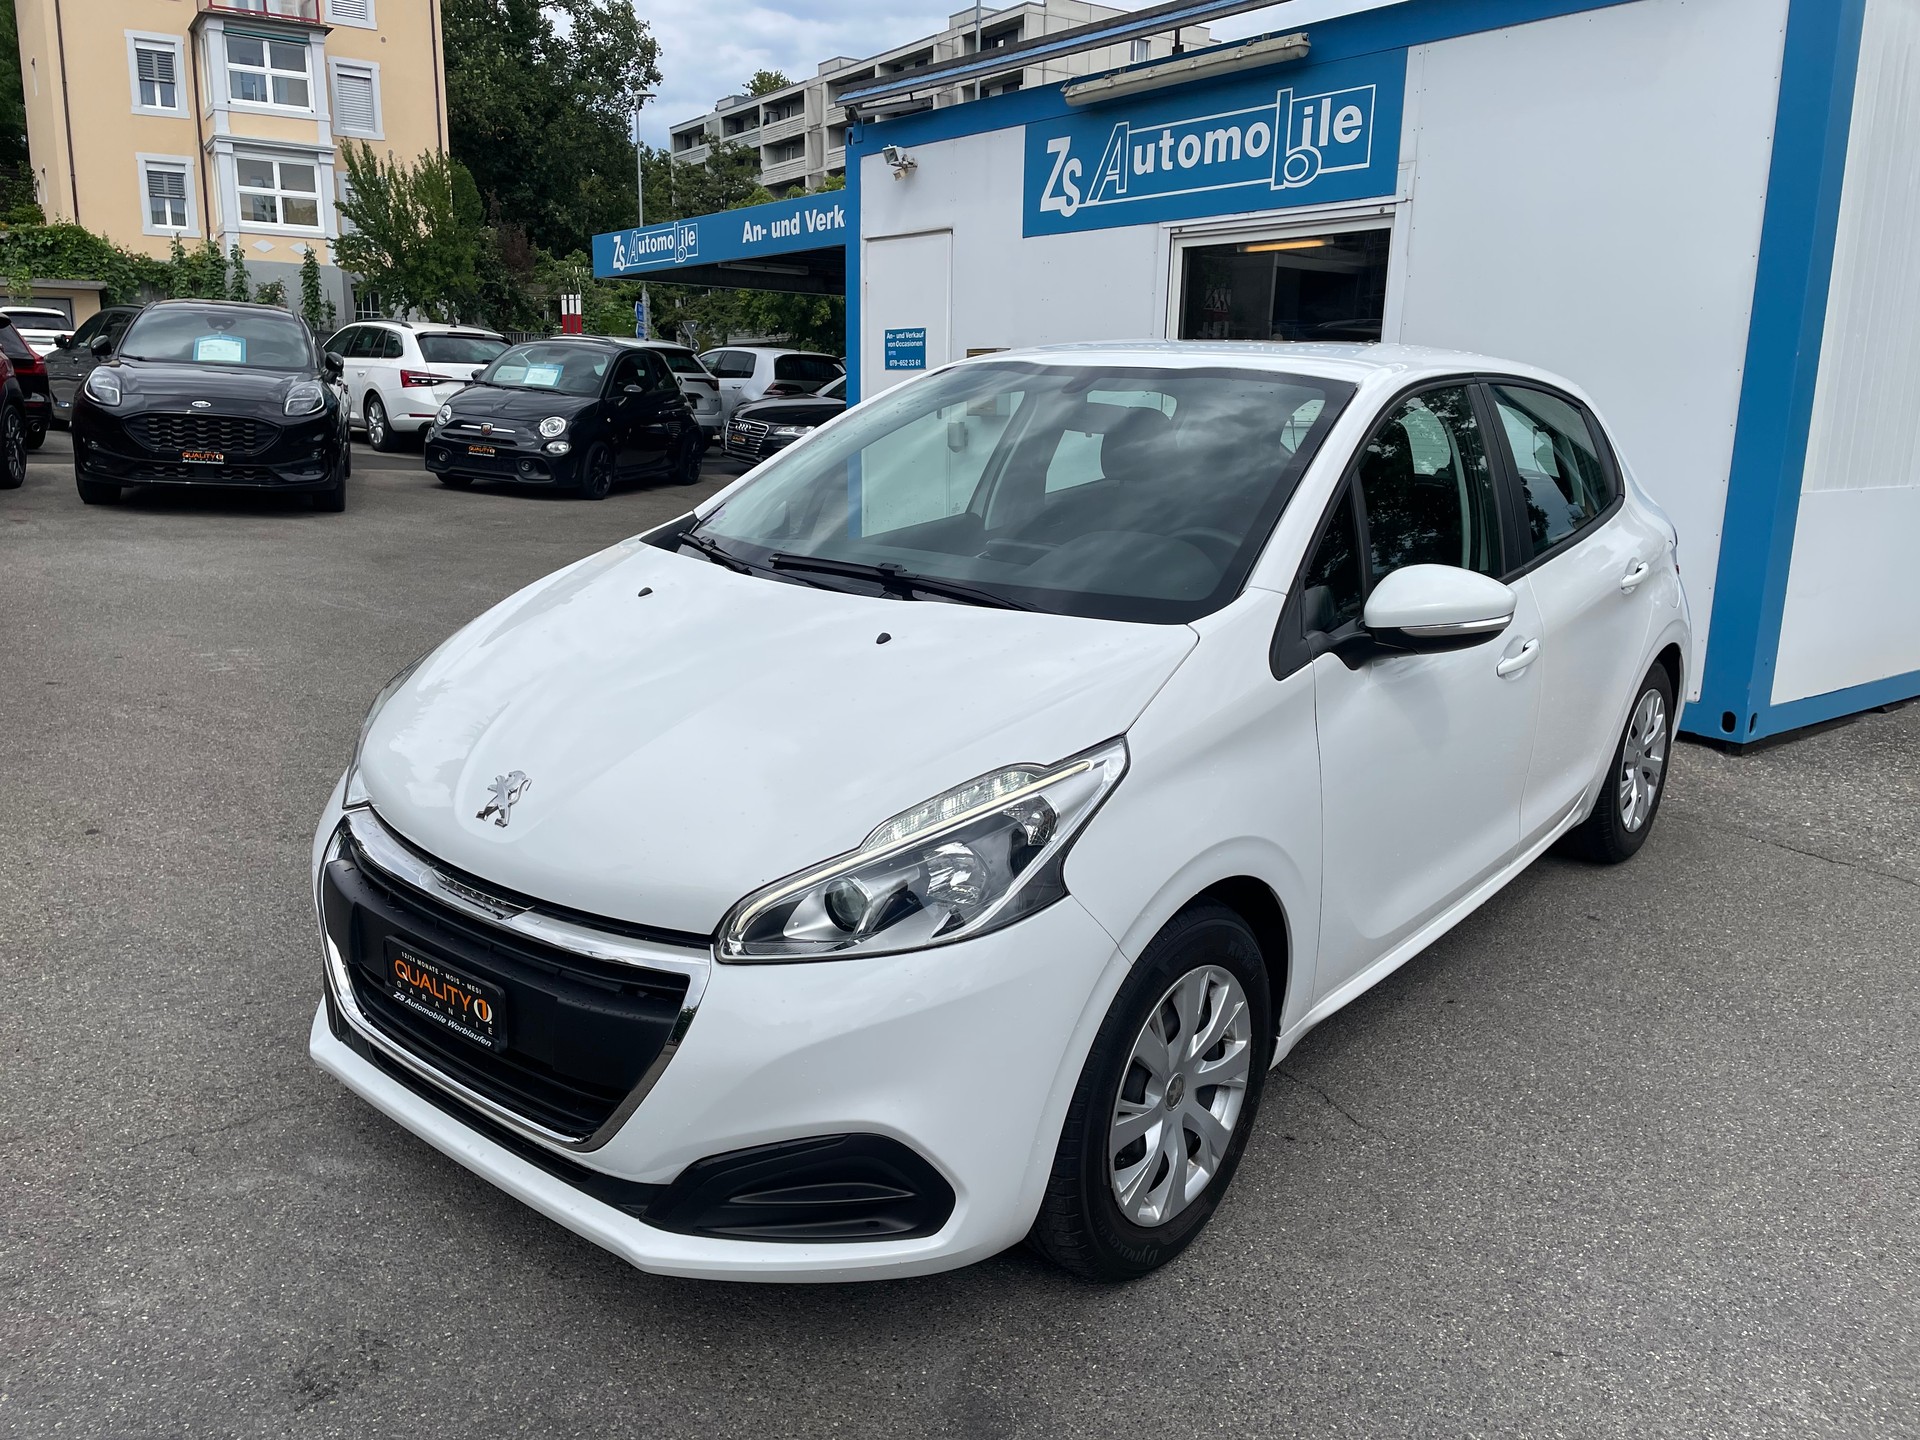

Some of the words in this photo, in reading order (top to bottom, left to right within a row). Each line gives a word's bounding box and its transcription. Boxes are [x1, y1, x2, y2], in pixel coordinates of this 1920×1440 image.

[1085, 87, 1365, 204] Automobile
[627, 222, 697, 264] Automobile
[742, 221, 767, 243] An-
[771, 211, 800, 239] und
[805, 204, 846, 233] Verk
[905, 331, 924, 339] Verkauf
[394, 959, 472, 1012] QUALITY
